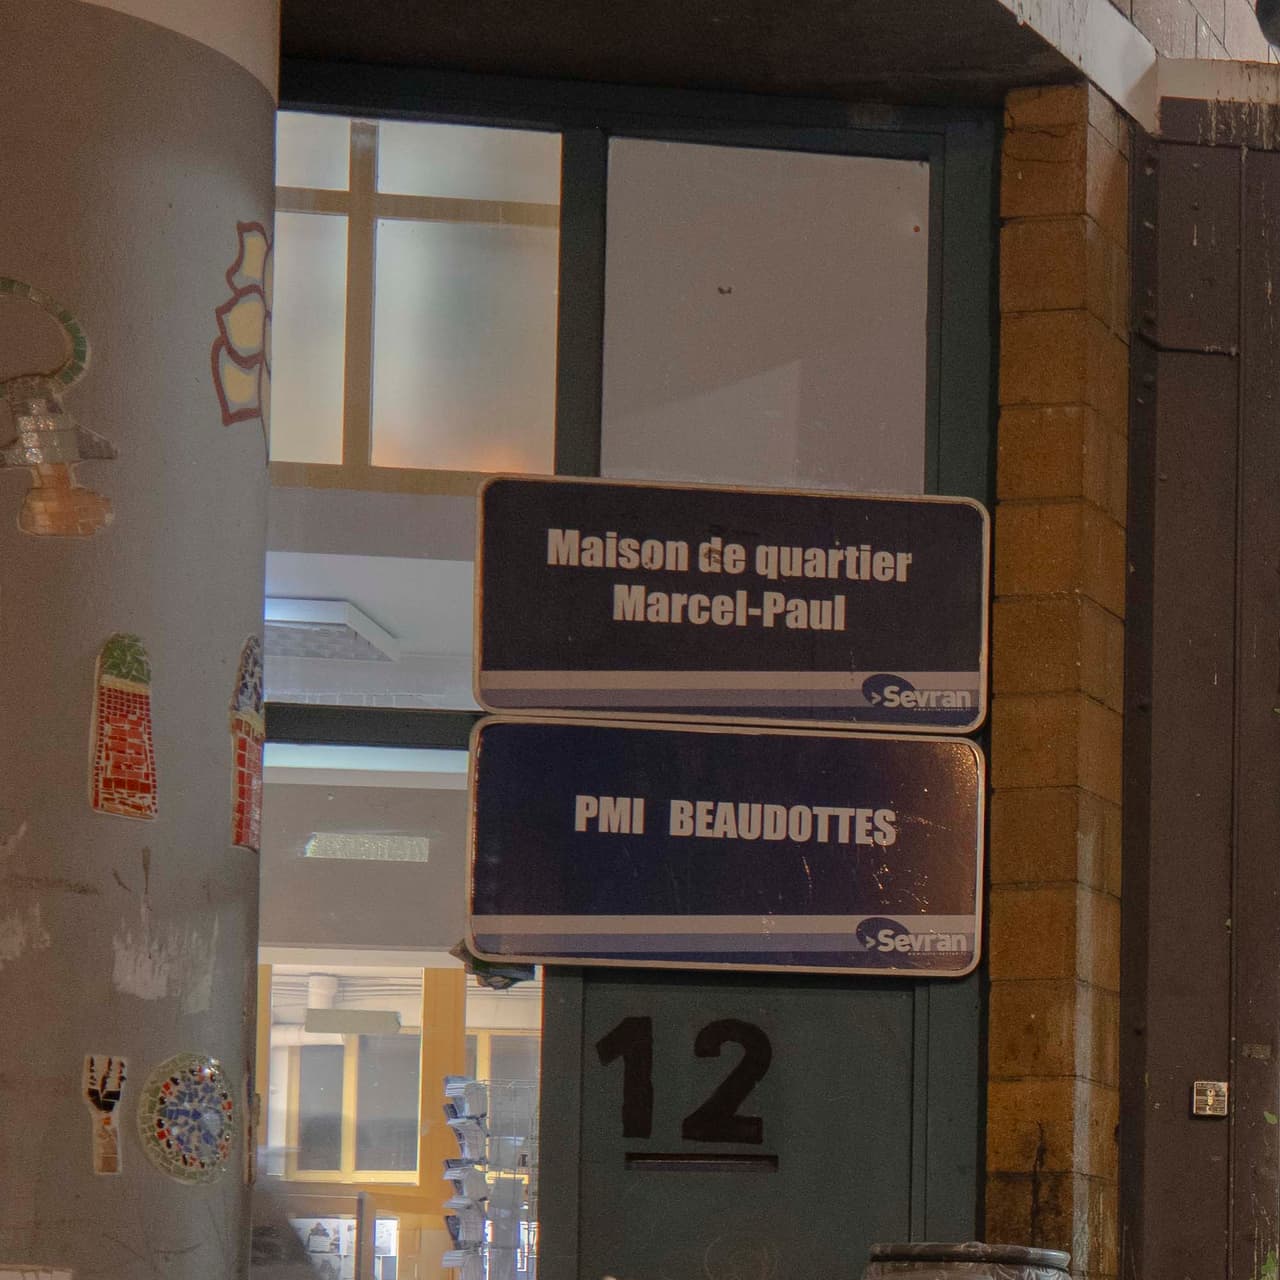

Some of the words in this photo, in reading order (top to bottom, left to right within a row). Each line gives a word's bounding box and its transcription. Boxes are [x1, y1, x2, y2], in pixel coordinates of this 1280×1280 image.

[547, 528, 689, 572] Maison
[698, 535, 746, 575] de
[755, 541, 913, 583] quartier
[612, 584, 847, 632] Marcel-Paul
[883, 685, 971, 708] Sevran
[574, 794, 645, 834] PMI
[668, 799, 898, 847] BEAUDOTTES
[877, 928, 968, 952] Sevran
[595, 1015, 774, 1146] 12
